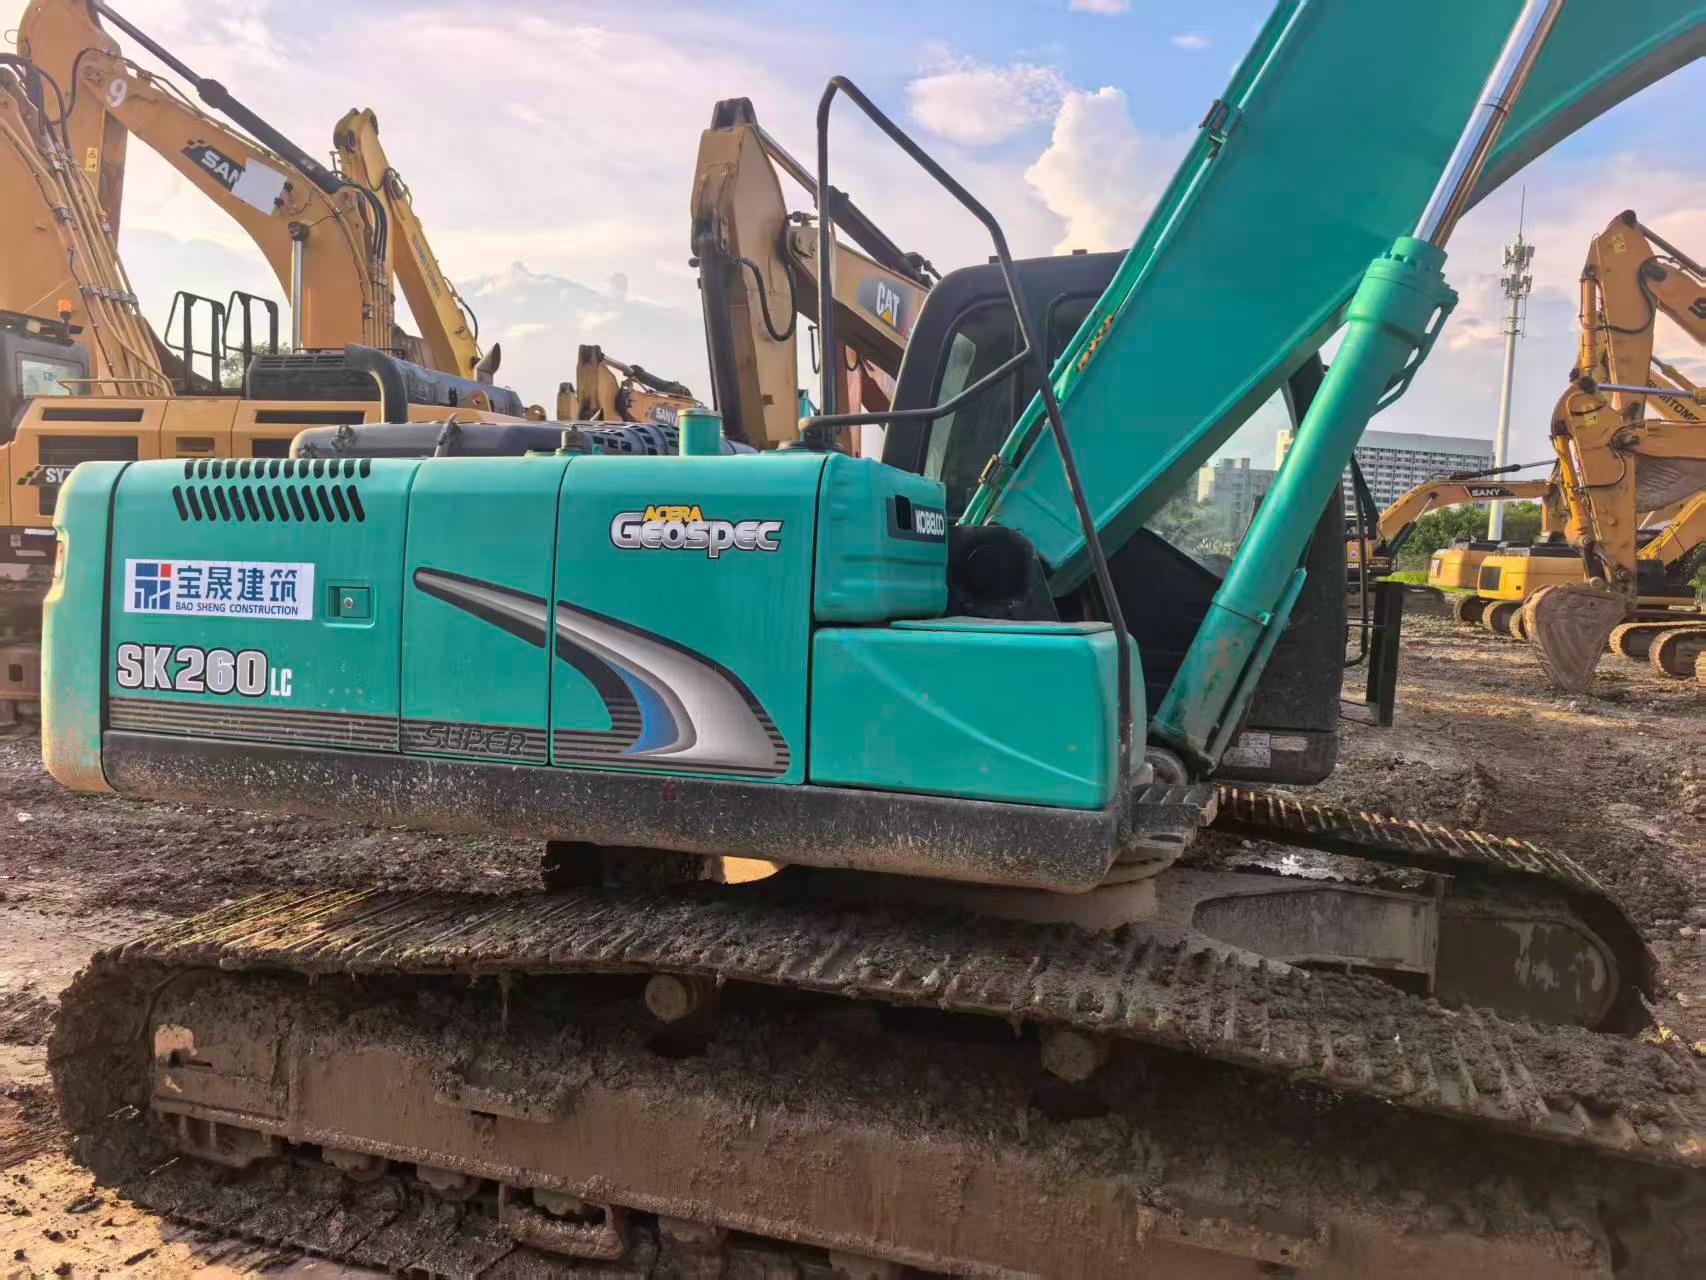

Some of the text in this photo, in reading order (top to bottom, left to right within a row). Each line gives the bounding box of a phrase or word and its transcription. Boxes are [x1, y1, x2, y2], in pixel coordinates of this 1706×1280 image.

[106, 78, 128, 108] 9
[876, 281, 900, 328] CAT
[655, 406, 676, 423] SANY
[1471, 488, 1501, 496] SANY
[641, 504, 704, 523] ACERA
[915, 509, 945, 536] KOBELCO
[176, 565, 298, 603] 宝晟建筑
[175, 601, 299, 616] BAO SHENG CONSTRUCTION
[422, 725, 528, 757] SUPER
